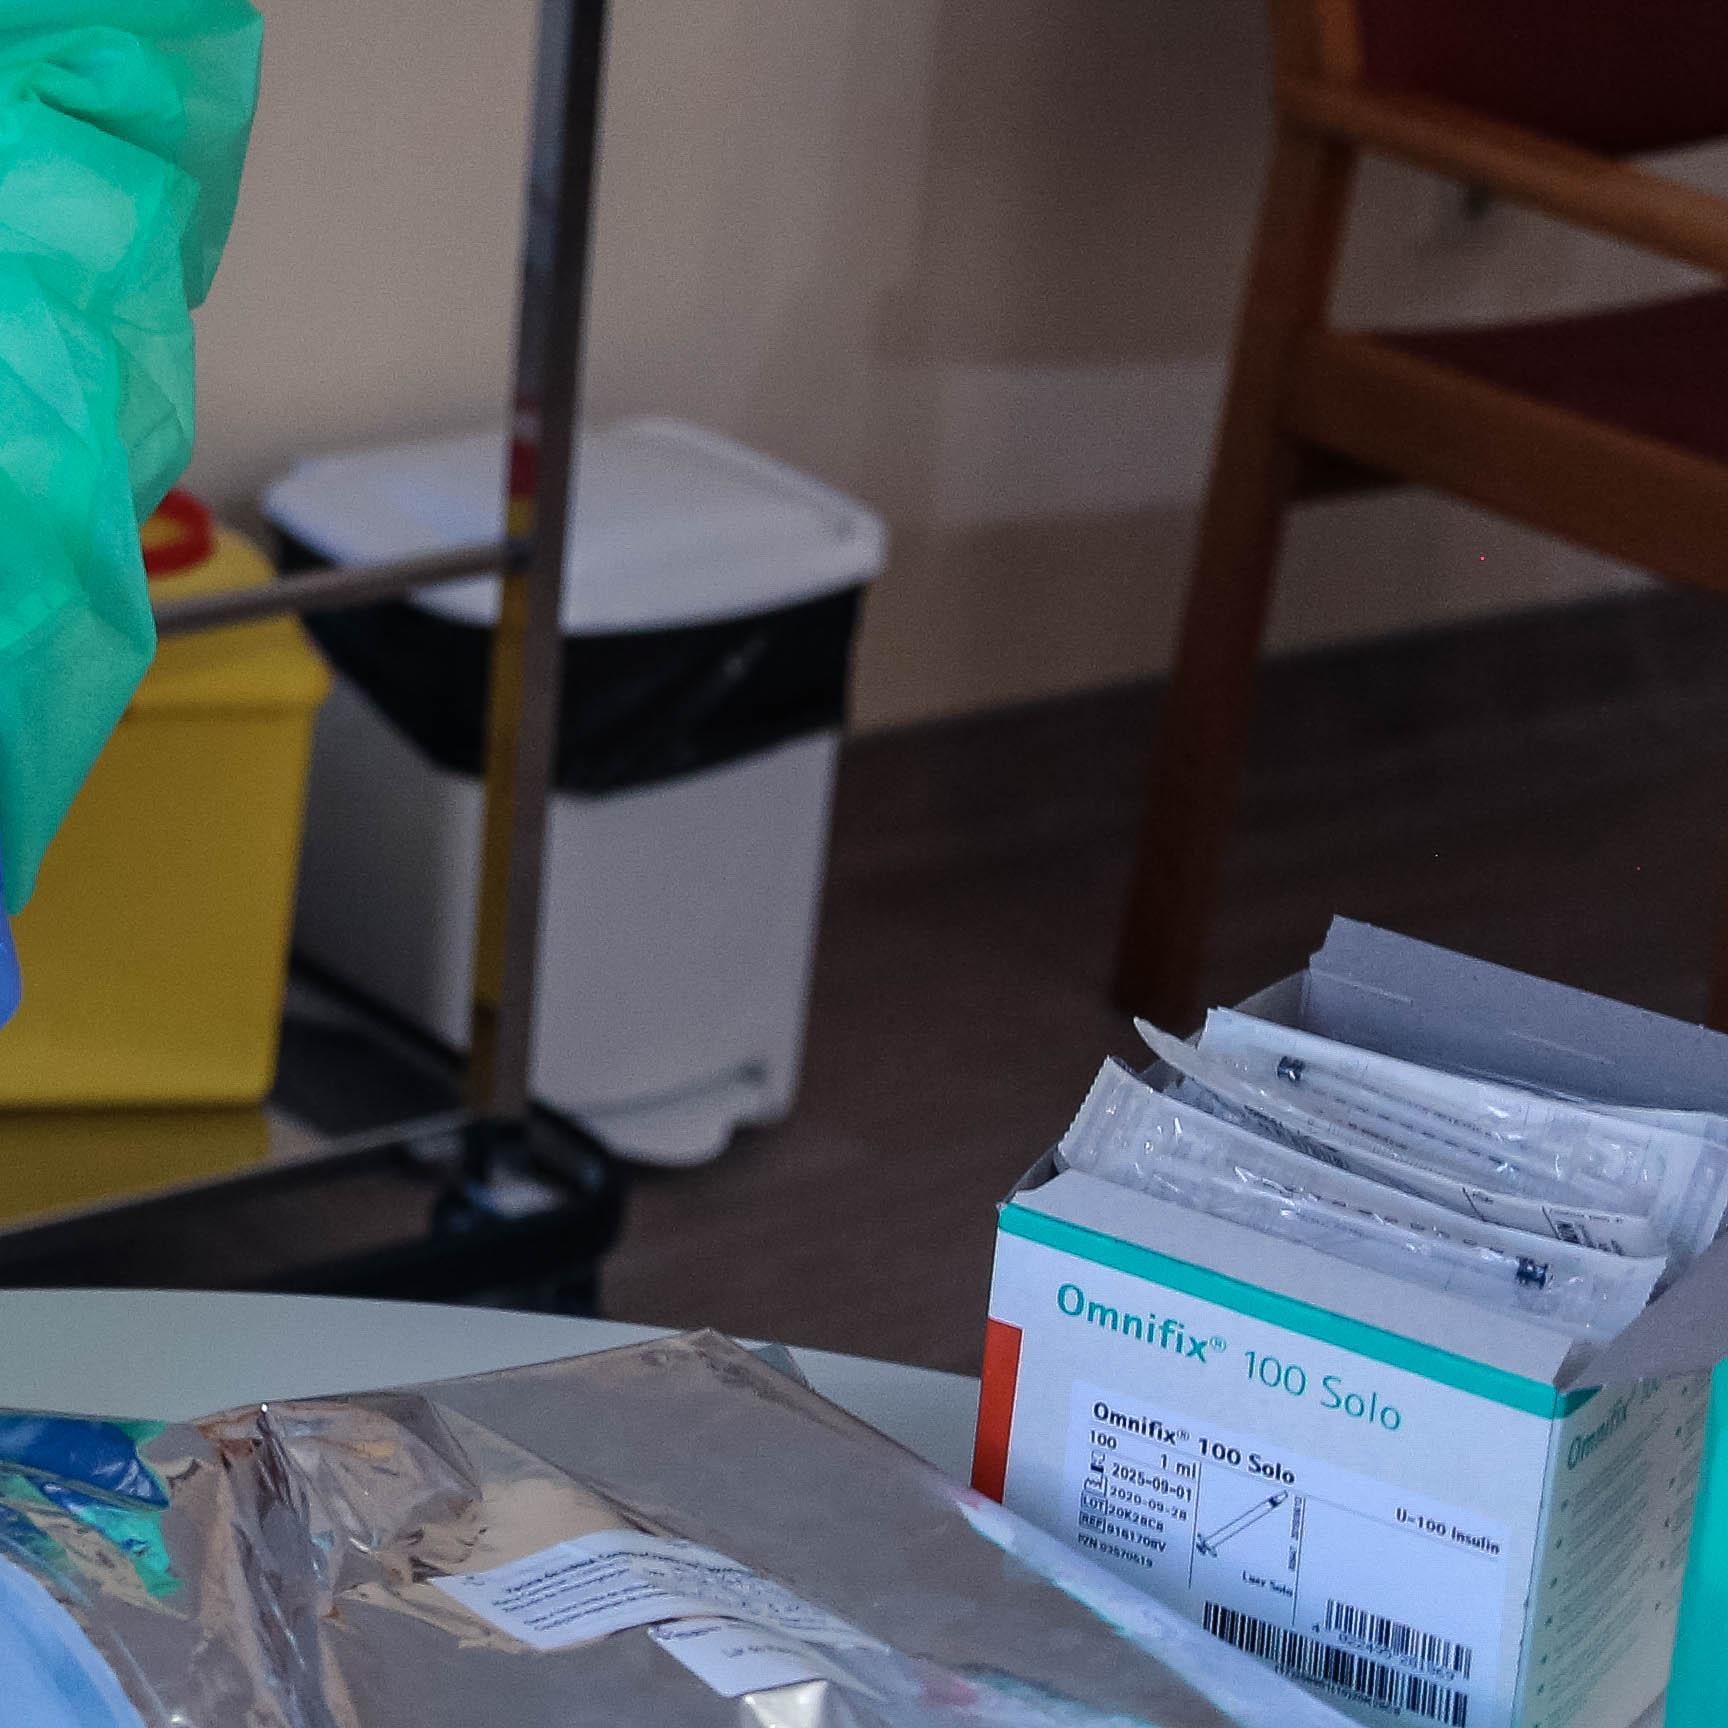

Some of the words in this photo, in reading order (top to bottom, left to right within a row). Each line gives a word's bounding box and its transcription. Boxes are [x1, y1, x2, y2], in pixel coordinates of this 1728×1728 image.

[1243, 1349, 1307, 1398] 100
[1319, 1375, 1402, 1434] Solo
[1089, 1429, 1118, 1451] 100
[1175, 1460, 1197, 1480] ml
[1197, 1437, 1243, 1466] 100
[1247, 1452, 1296, 1486] Solo
[1083, 1494, 1106, 1515] LOT
[1450, 1525, 1502, 1556] Insulin
